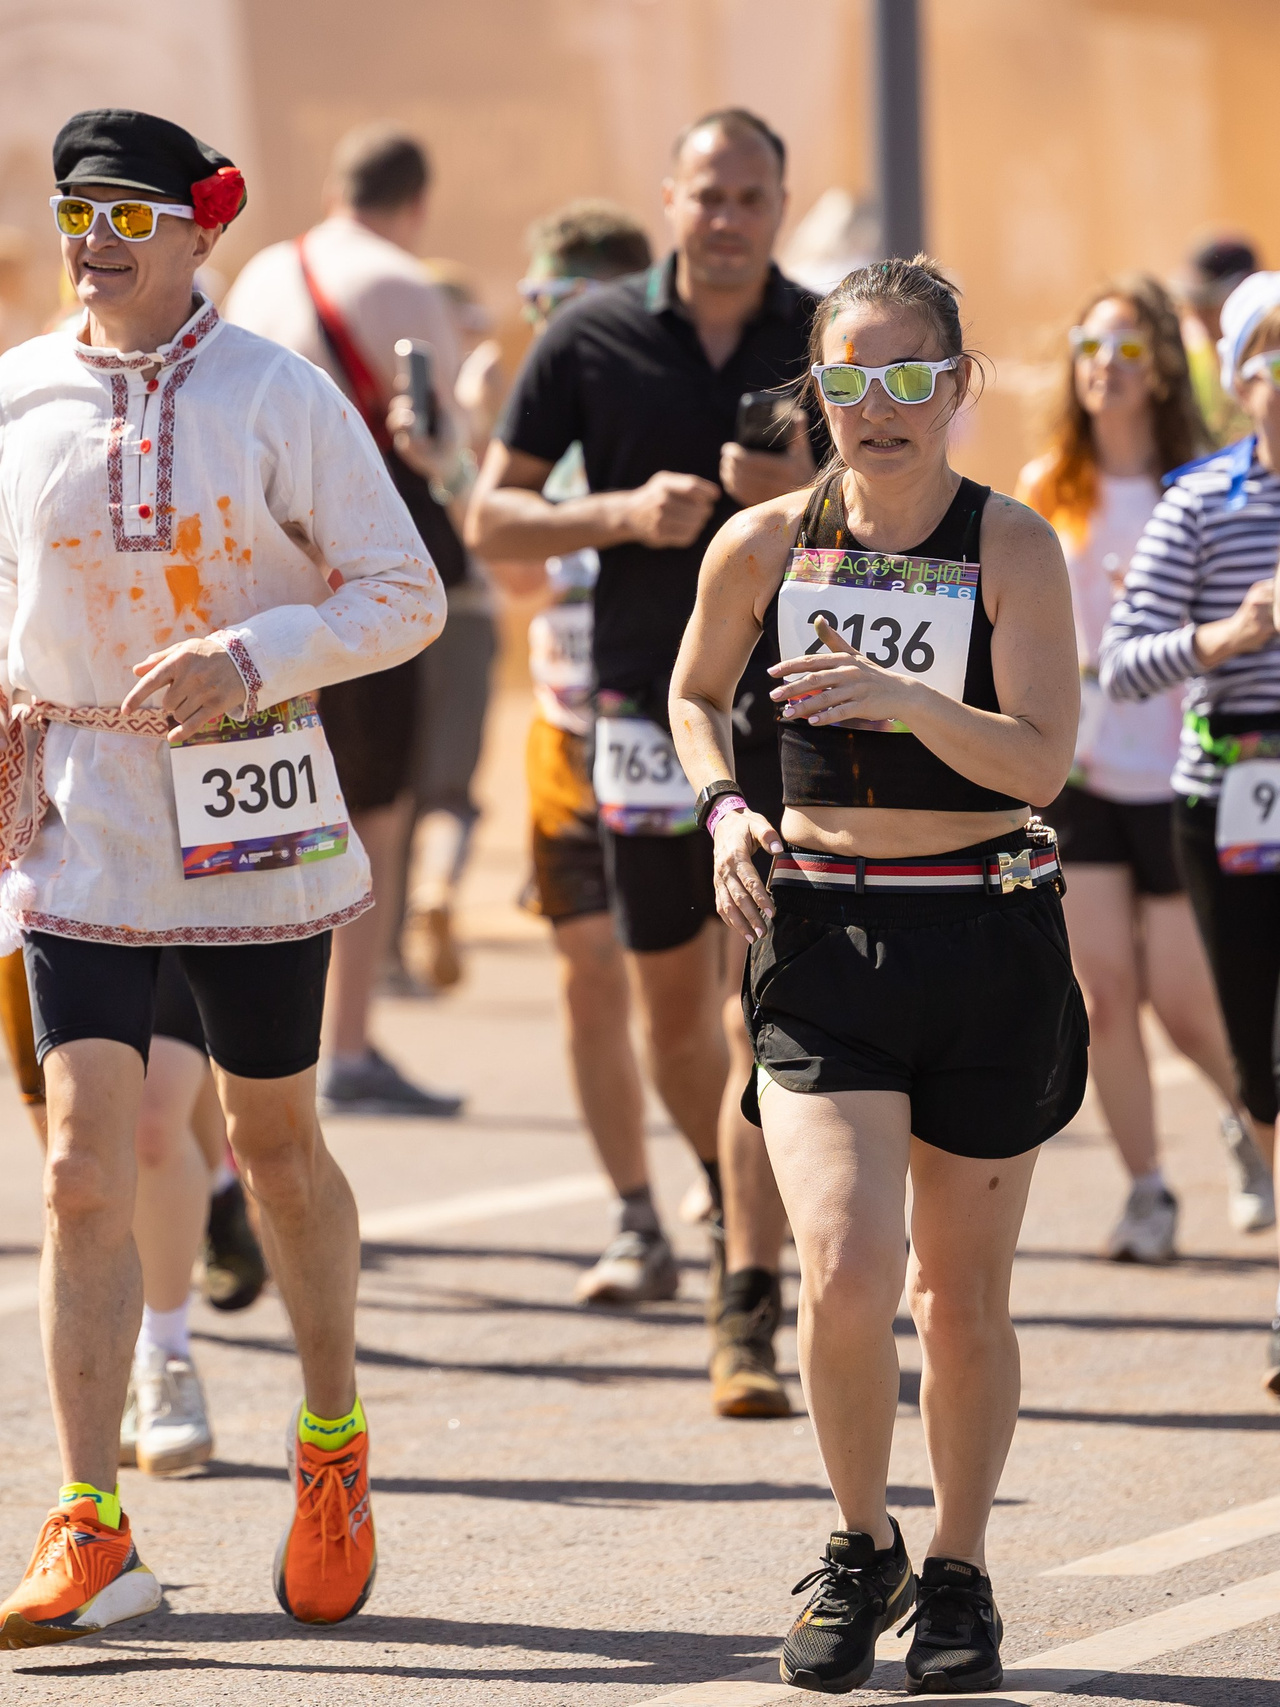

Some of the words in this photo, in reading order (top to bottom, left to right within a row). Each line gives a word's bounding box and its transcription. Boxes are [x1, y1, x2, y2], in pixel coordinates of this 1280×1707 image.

[801, 554, 962, 585] КРАСОЧНЫЙ
[890, 580, 972, 600] 2026
[804, 609, 935, 673] 2136
[273, 714, 320, 737] 2026
[608, 743, 686, 785] 763
[201, 754, 318, 818] 3301
[943, 1562, 972, 1576] Joma
